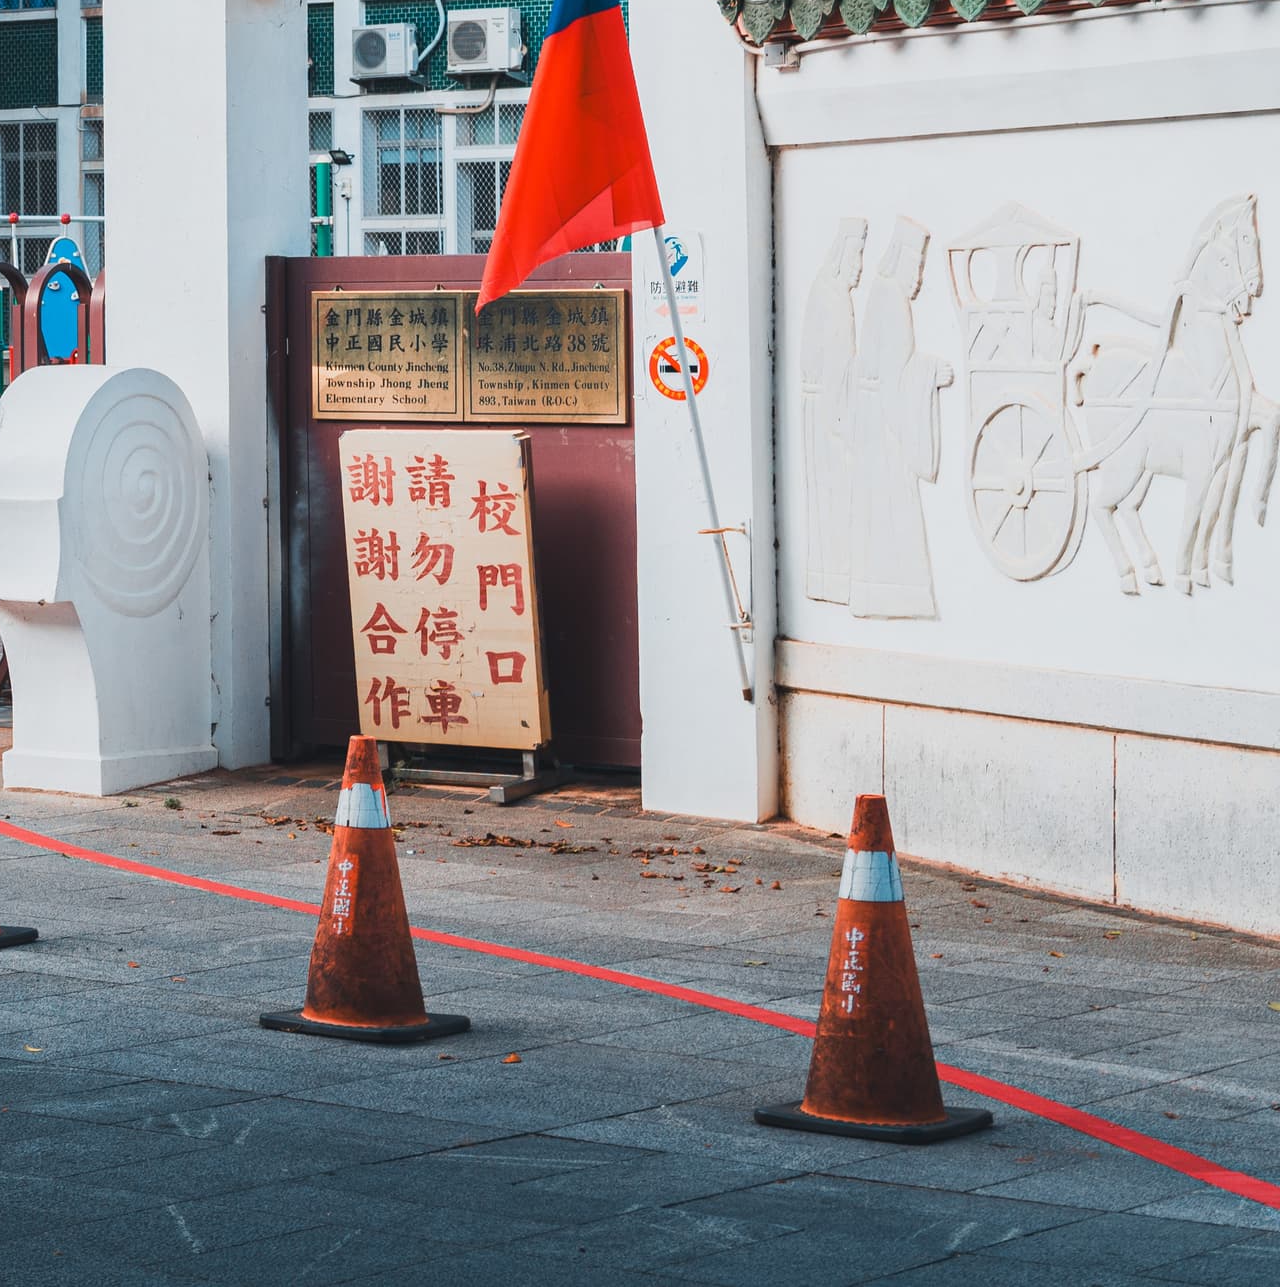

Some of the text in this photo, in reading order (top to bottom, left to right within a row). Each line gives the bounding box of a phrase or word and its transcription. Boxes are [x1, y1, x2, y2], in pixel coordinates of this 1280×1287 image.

[650, 280, 698, 294] 防避難
[325, 307, 449, 327] 金門縣金城鎮
[325, 333, 449, 353] 中正國民小學
[326, 360, 449, 375] Kinmen County Jincheng
[326, 379, 449, 390] Township Jhong Jheng
[574, 380, 610, 392] County
[325, 394, 427, 405] Elementary School
[347, 454, 412, 729] 謝謝合作
[468, 480, 527, 685] 校門口
[405, 454, 470, 735] 請勿停車
[842, 927, 865, 1013] 中正國小
